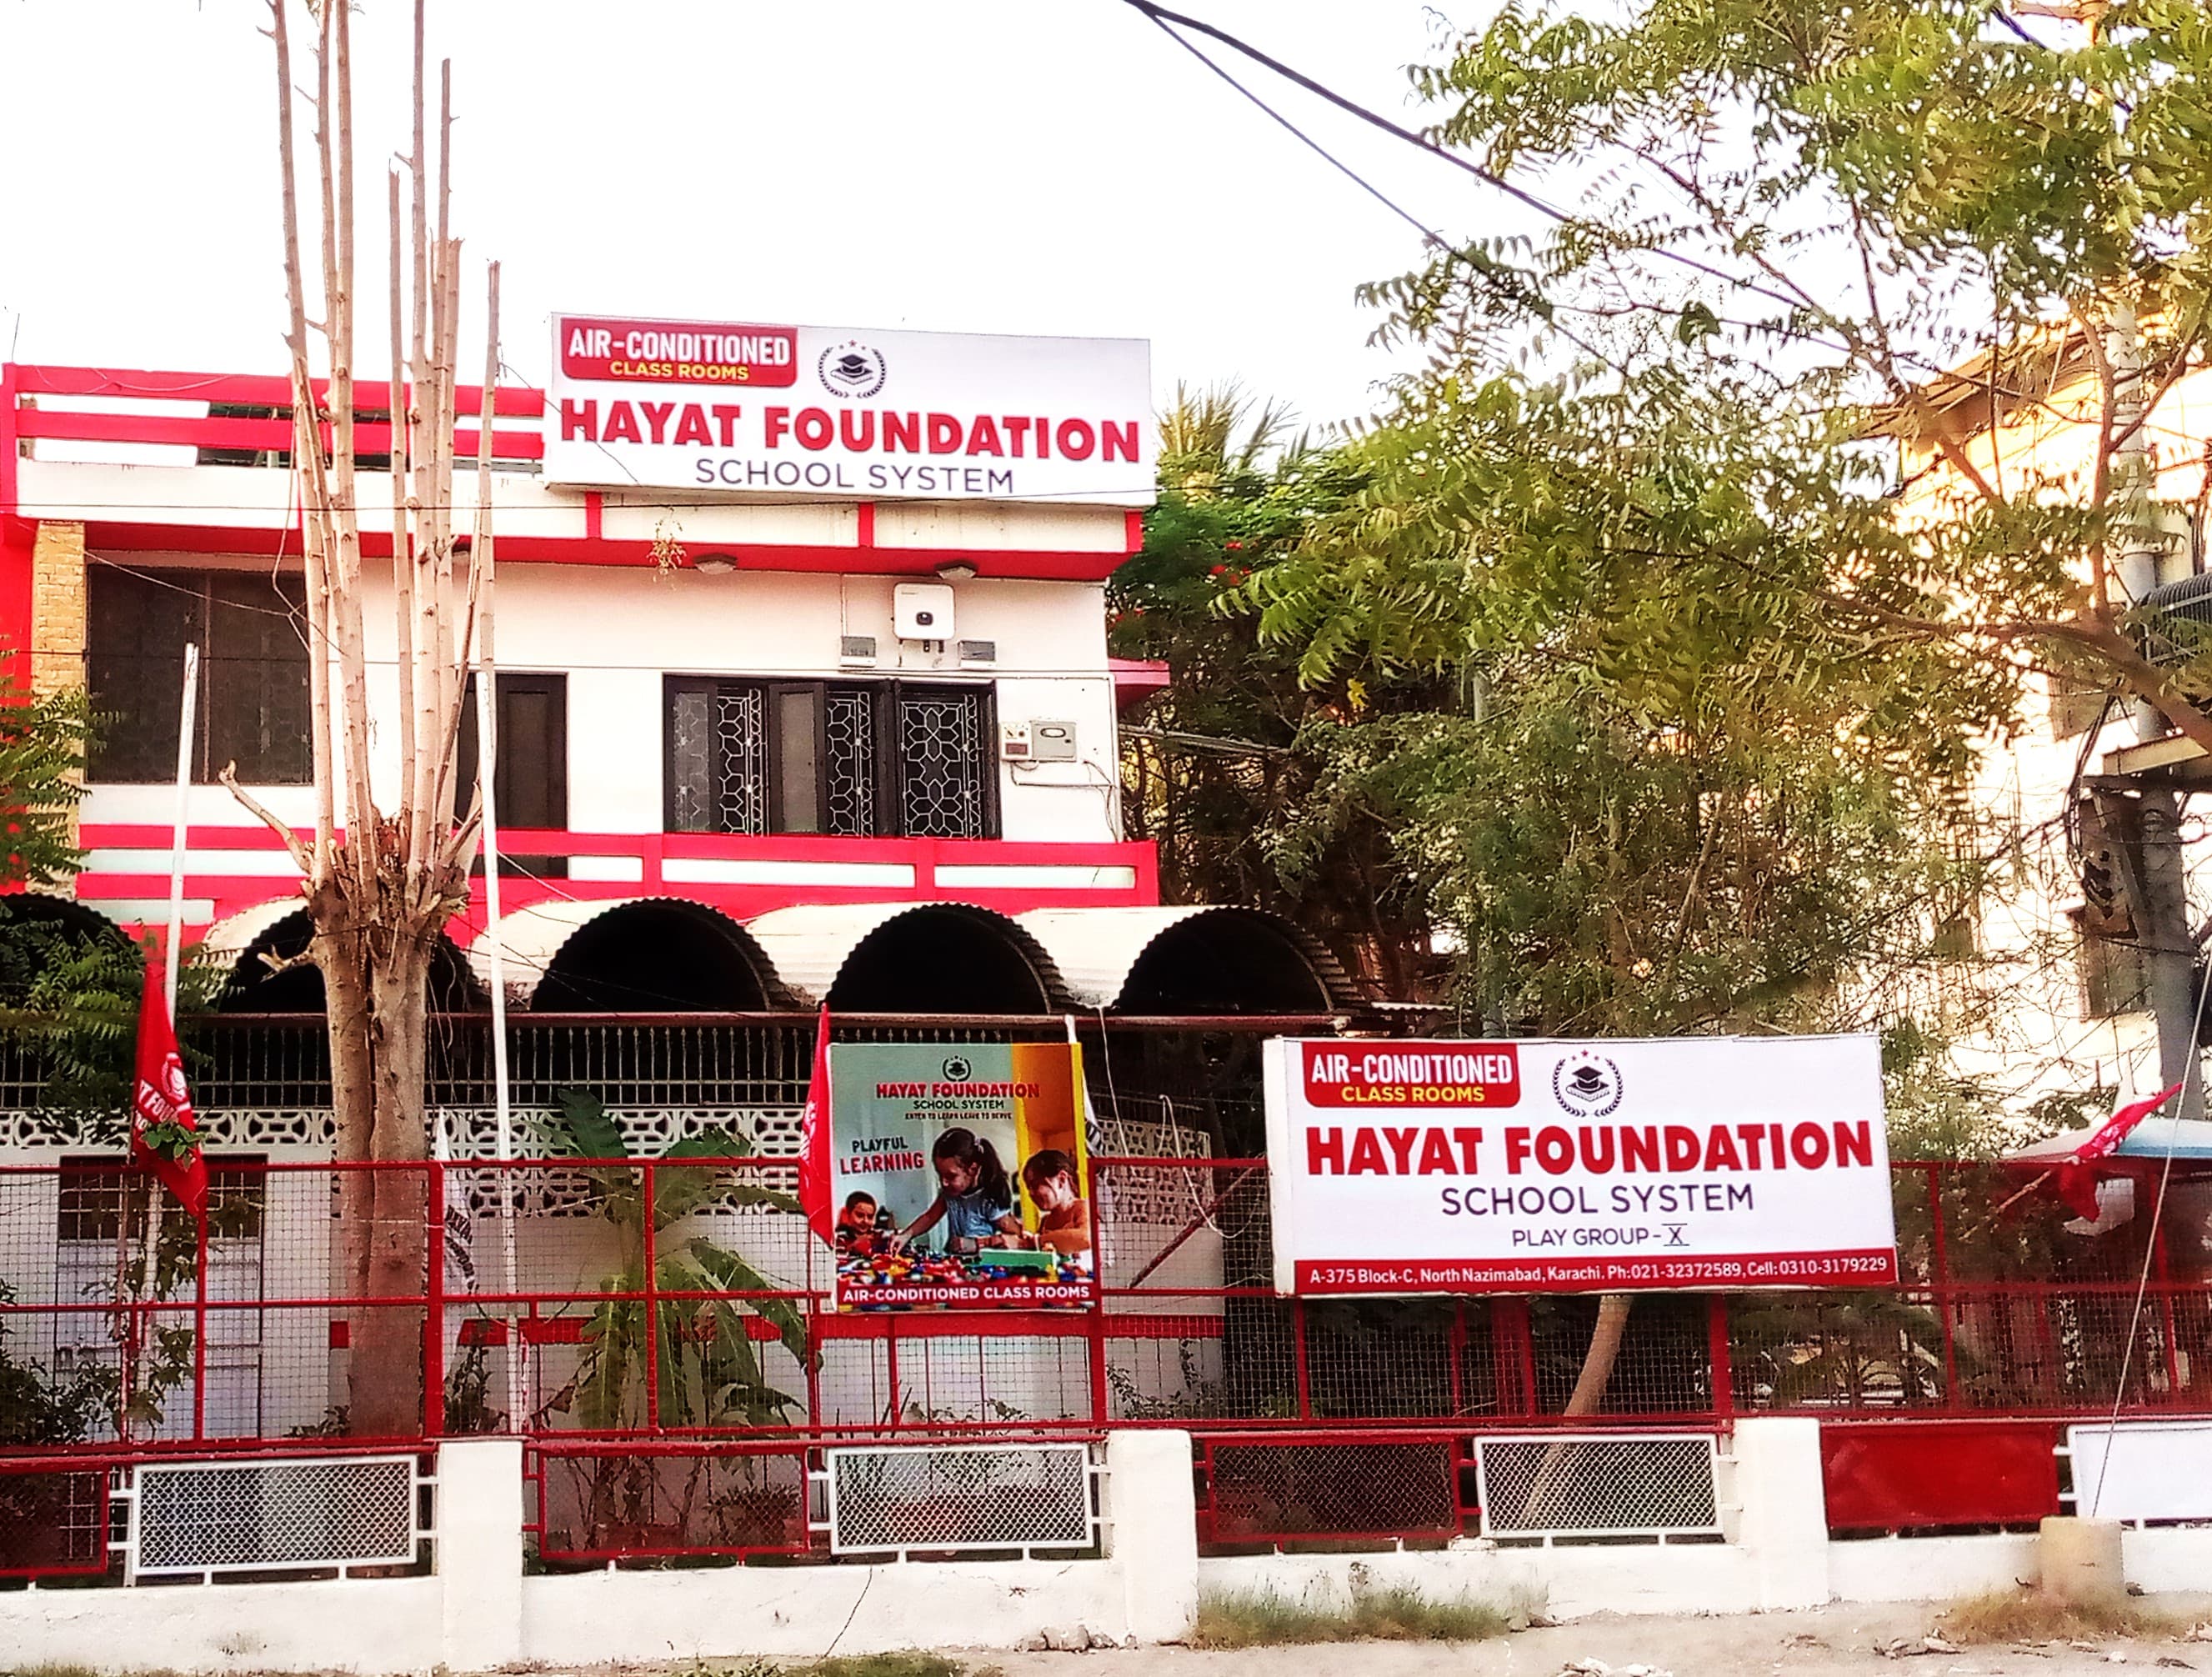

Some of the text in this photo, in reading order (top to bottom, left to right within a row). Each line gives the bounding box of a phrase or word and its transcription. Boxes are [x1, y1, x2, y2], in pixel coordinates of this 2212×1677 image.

[568, 328, 791, 366] AIR-CONDITIONED
[610, 361, 749, 380] CLASS ROOMS
[560, 398, 1140, 463] HAYAT FOUNDATION
[696, 458, 1013, 493] SCHOOL SYSTEM
[1311, 1054, 1514, 1084] AIR-CONDITIONED
[876, 1083, 1040, 1099] HAYAT FOUNDATION
[1341, 1086, 1485, 1102] CLASS ROOMS
[913, 1099, 1004, 1109] SCHOOL SYSTEM
[852, 1137, 908, 1153] PLAYFUL
[1306, 1121, 1874, 1175] HAYAT FOUNDATION
[840, 1152, 924, 1174] LEARNING
[1441, 1183, 1754, 1215] SCHOOL SYSTEM
[1512, 1229, 1567, 1247] PLAY
[1310, 1269, 1356, 1284] A-375
[1359, 1269, 1418, 1284] Block-C,
[1420, 1268, 1460, 1283] North
[1463, 1266, 1546, 1284] Nazimabad,
[1548, 1265, 1605, 1280] Karachi.
[843, 1285, 1089, 1301] AIR-CONDITIONED CLASS ROOMS
